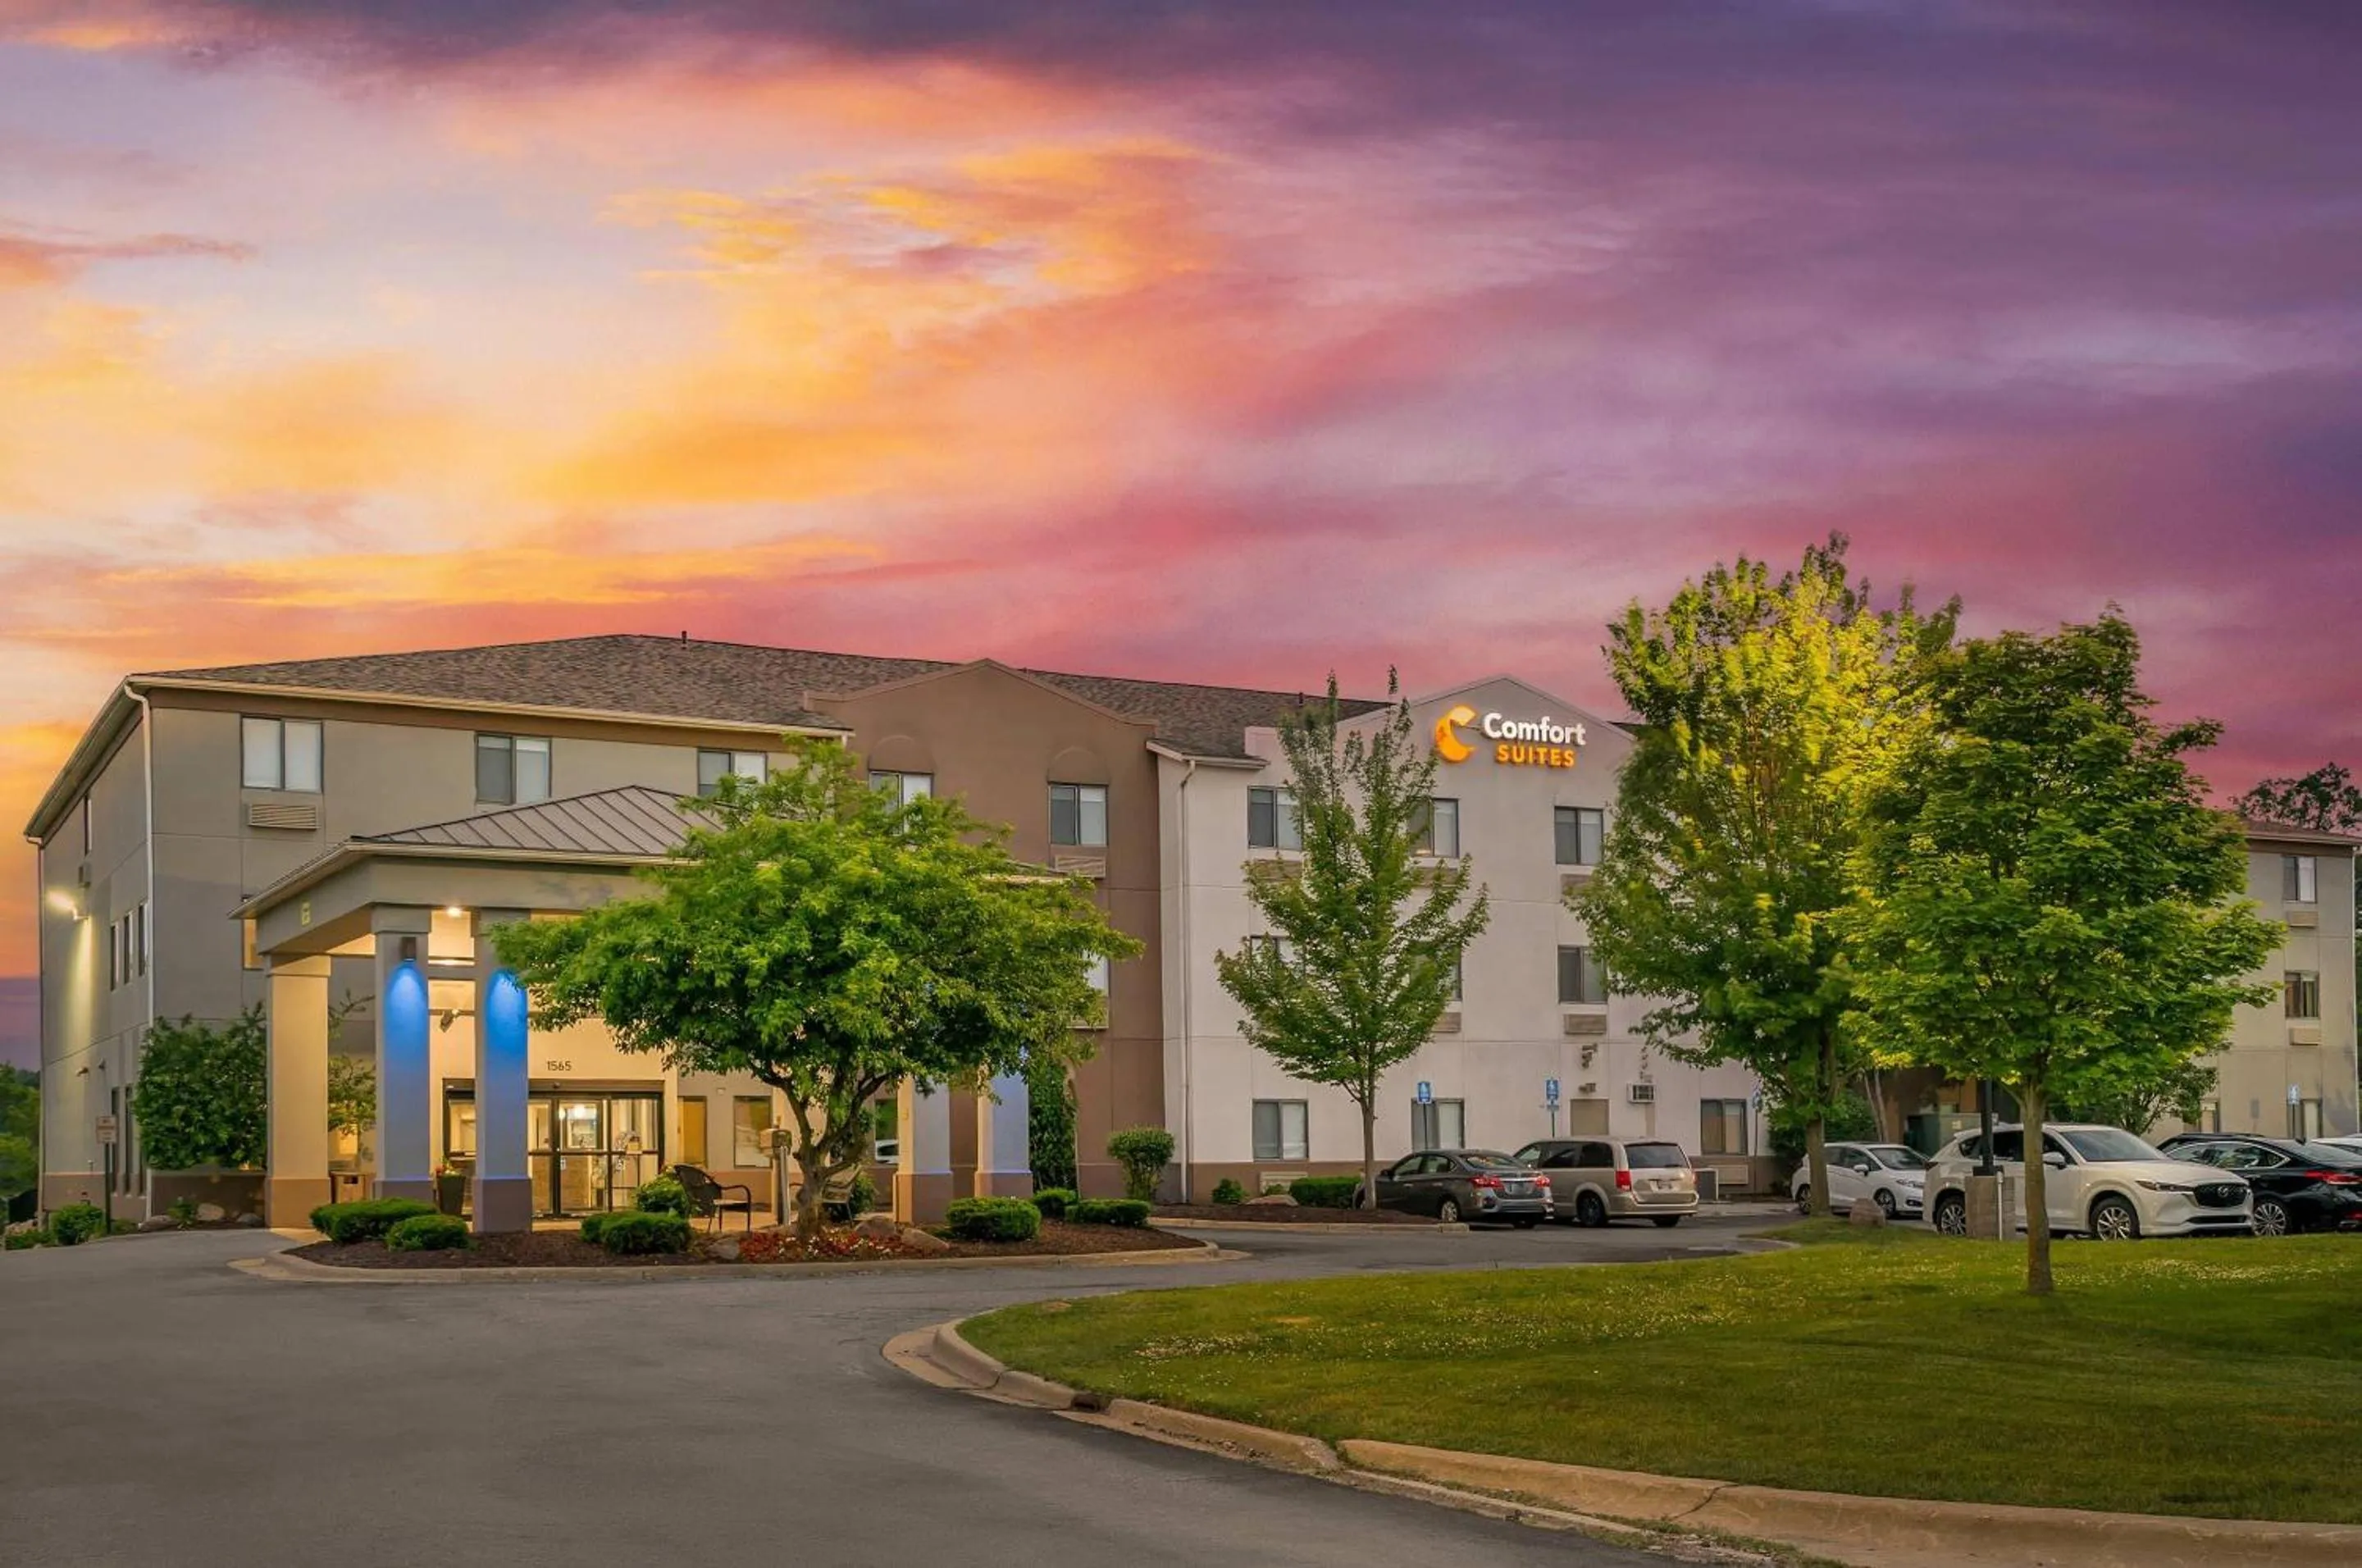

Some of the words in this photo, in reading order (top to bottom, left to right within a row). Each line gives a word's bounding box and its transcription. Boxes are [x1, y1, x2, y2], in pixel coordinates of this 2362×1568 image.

[1484, 712, 1586, 745] Comfort
[1497, 744, 1575, 768] SUITES
[547, 1060, 572, 1071] 1565
